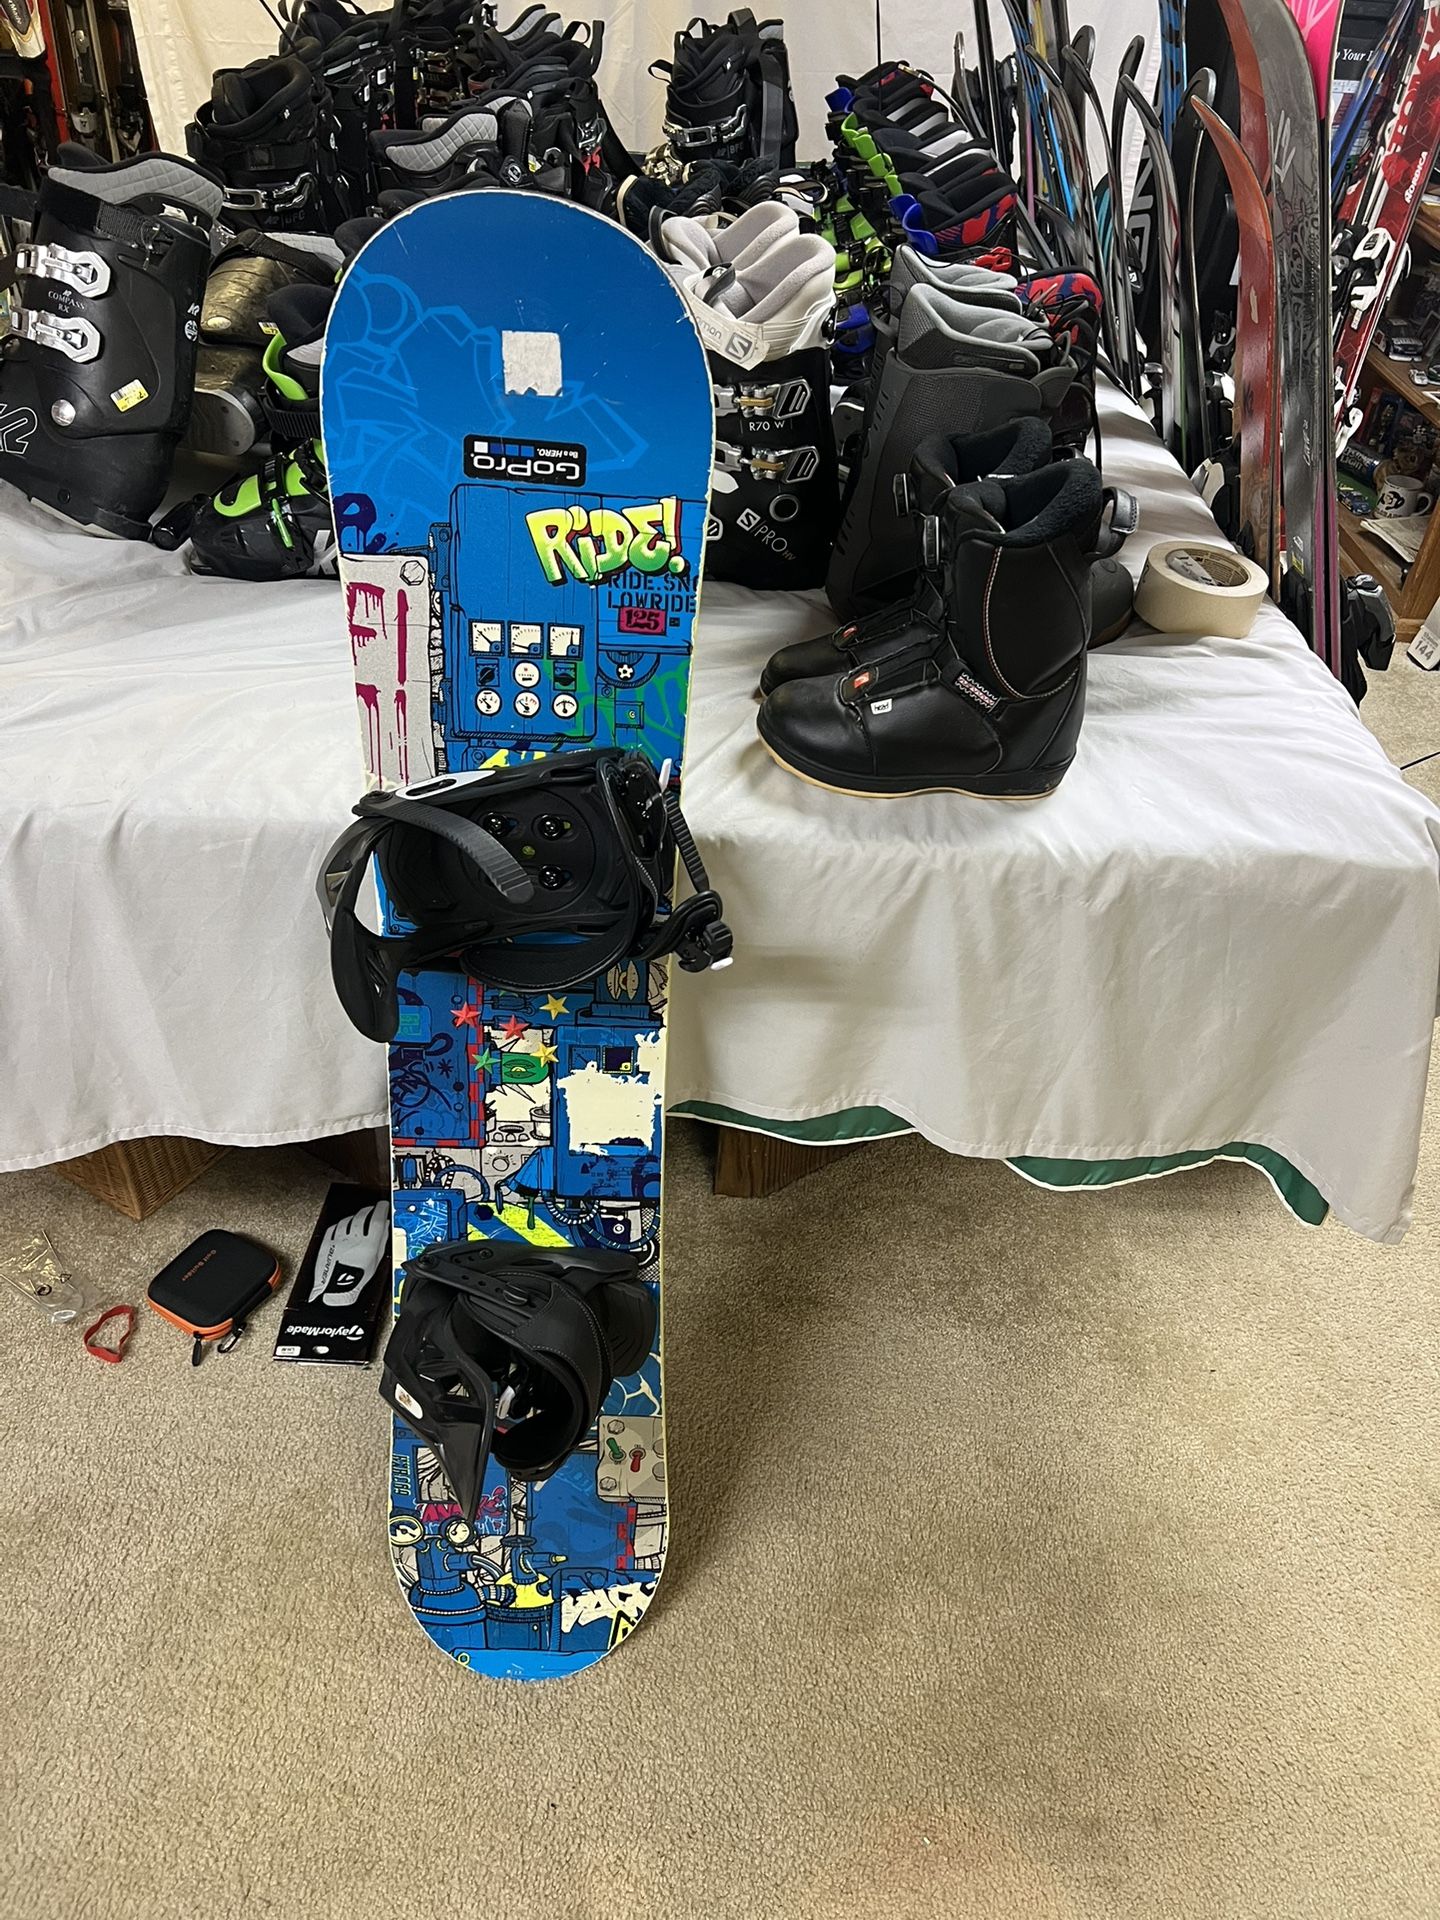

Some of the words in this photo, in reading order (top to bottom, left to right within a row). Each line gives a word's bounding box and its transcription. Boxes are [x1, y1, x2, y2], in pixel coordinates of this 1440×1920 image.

[1343, 48, 1366, 61] Your
[1403, 151, 1428, 204] NORDICA
[47, 290, 87, 310] COMPASS
[748, 421, 771, 432] R70
[774, 419, 786, 429] W
[625, 608, 661, 631] 125
[1415, 640, 1434, 660] 144
[286, 1324, 365, 1341] TaylorMade
